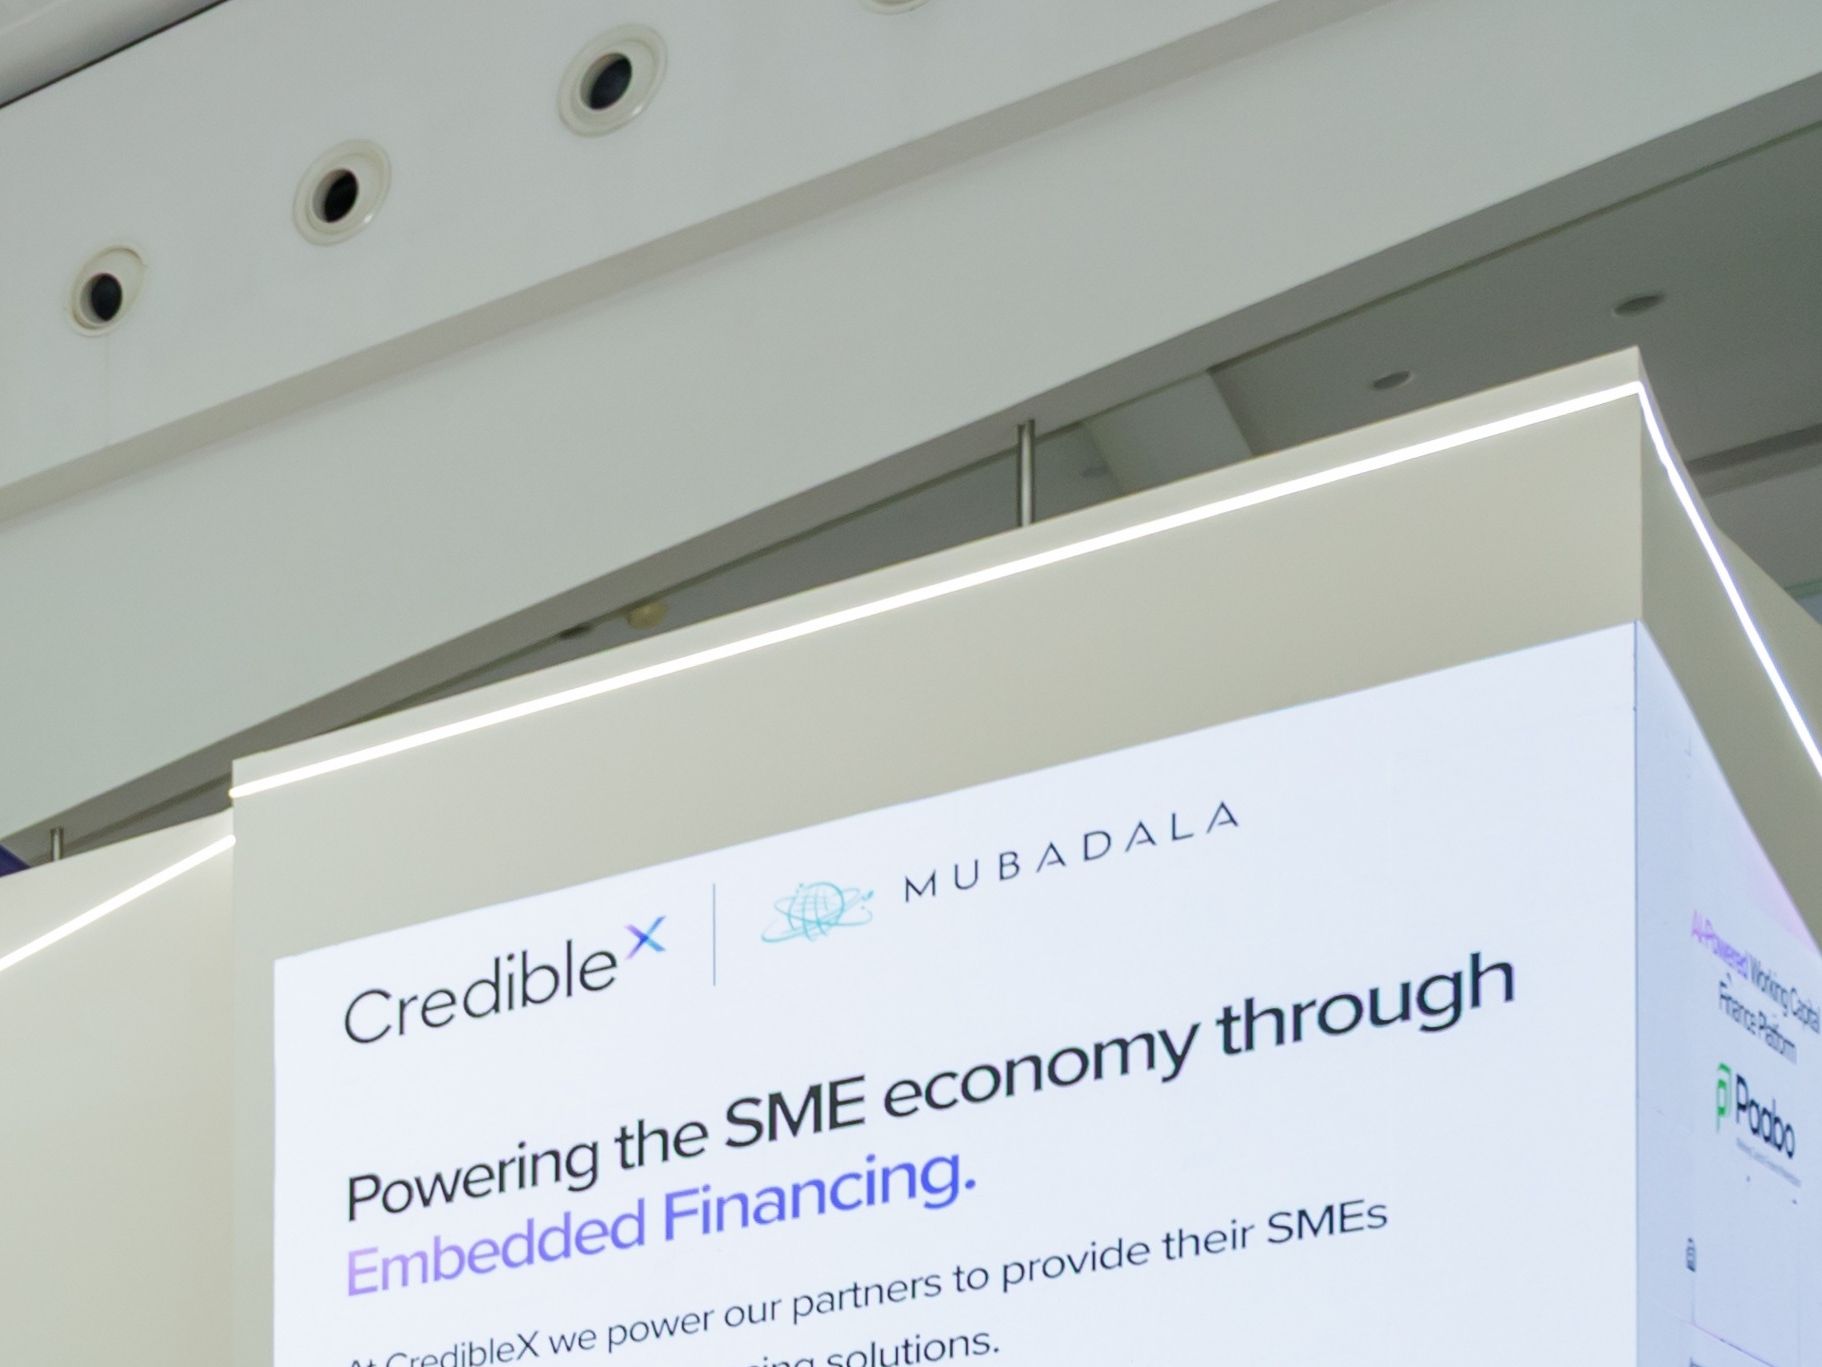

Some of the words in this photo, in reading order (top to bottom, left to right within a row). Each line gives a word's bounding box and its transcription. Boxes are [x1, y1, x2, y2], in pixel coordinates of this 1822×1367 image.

[904, 802, 1239, 903] MUBADALA
[348, 1141, 599, 1222] Powering
[614, 1118, 709, 1172] the
[726, 1074, 866, 1149] SME
[883, 1022, 1200, 1119] economy
[1216, 952, 1516, 1056] through
[346, 1198, 645, 1297] Embedded
[664, 1153, 976, 1241] Financing.
[549, 1326, 598, 1355] we
[607, 1309, 715, 1353] power
[724, 1298, 782, 1327] our
[793, 1273, 942, 1325] partners
[953, 1263, 990, 1292] to
[1002, 1238, 1151, 1293] provide
[1161, 1219, 1255, 1261] their
[1267, 1199, 1389, 1245] SMEs
